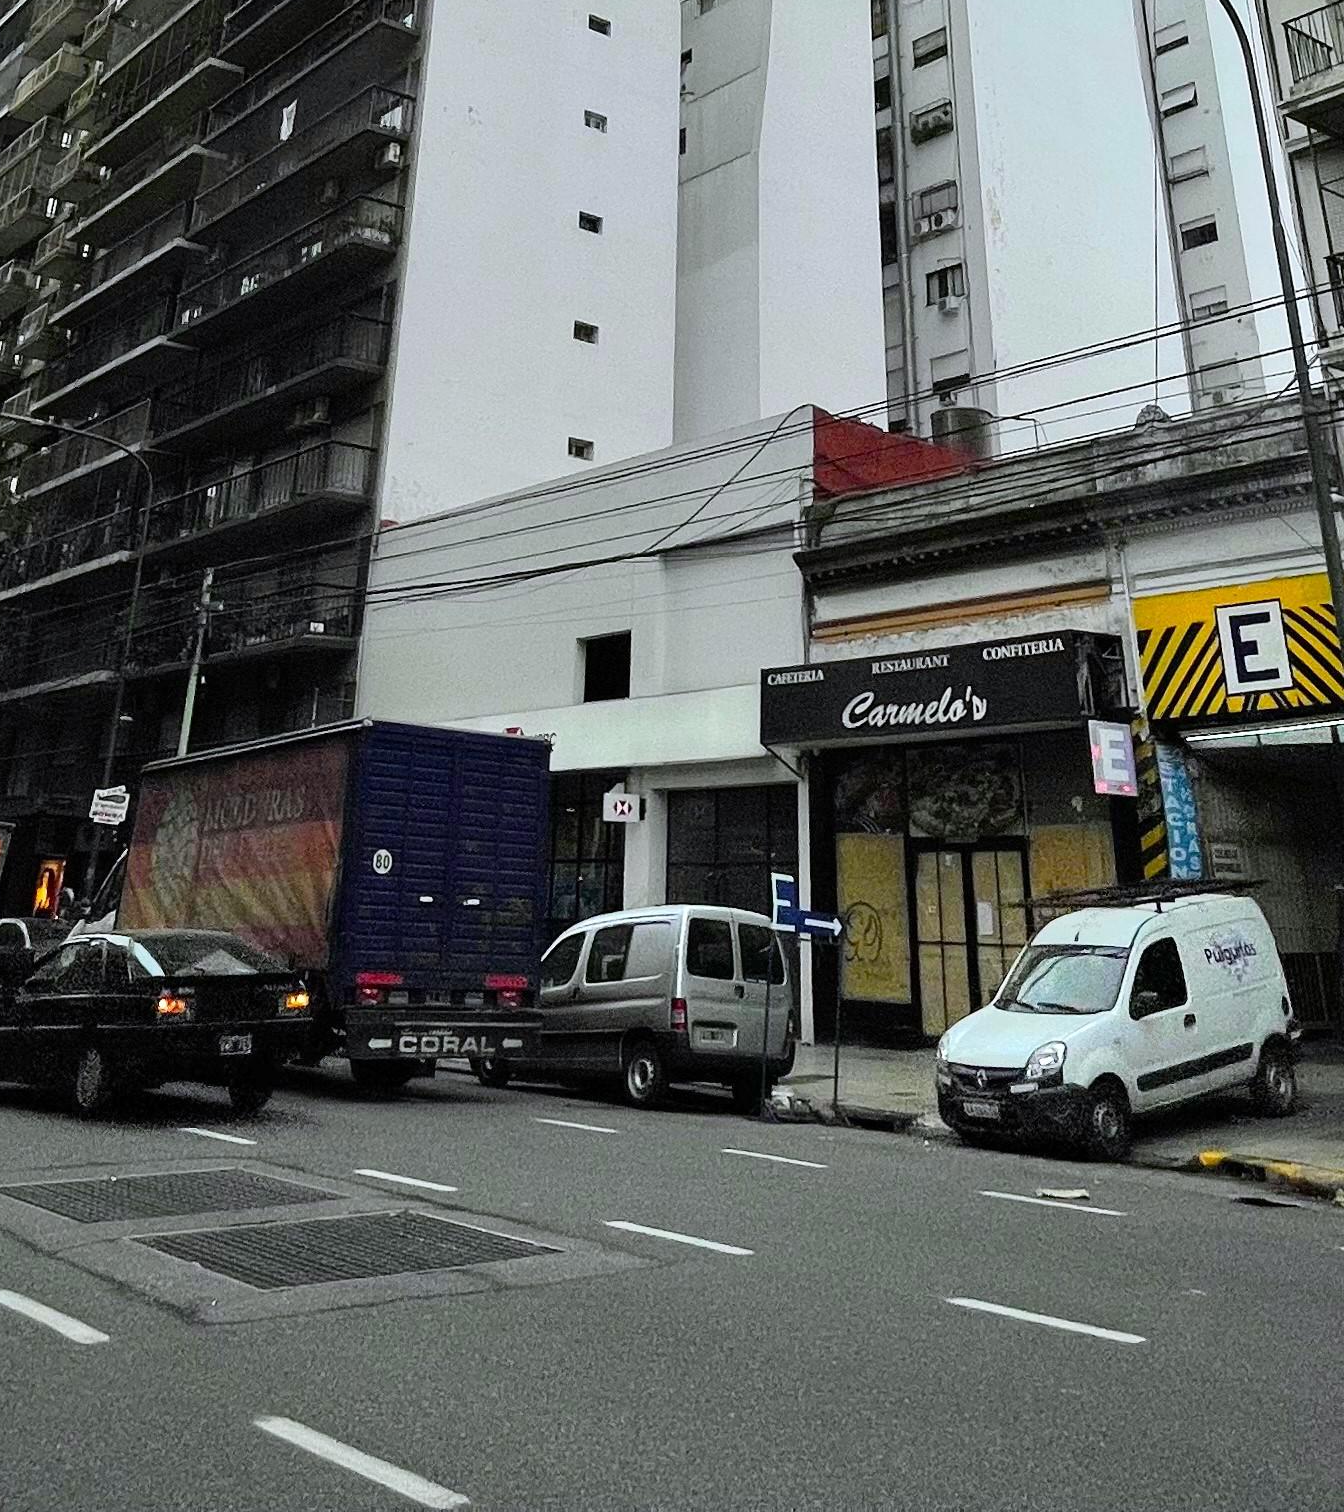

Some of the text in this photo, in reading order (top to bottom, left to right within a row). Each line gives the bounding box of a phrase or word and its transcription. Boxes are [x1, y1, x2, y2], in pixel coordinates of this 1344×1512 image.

[767, 638, 1065, 686] CAFETERIA RESTAURANT CONFITERIA
[1228, 611, 1281, 684] E
[841, 685, 988, 729] Carmelo's
[1098, 727, 1130, 782] E
[376, 854, 390, 869] 80
[770, 872, 796, 932] E
[398, 1035, 496, 1053] CORAL
